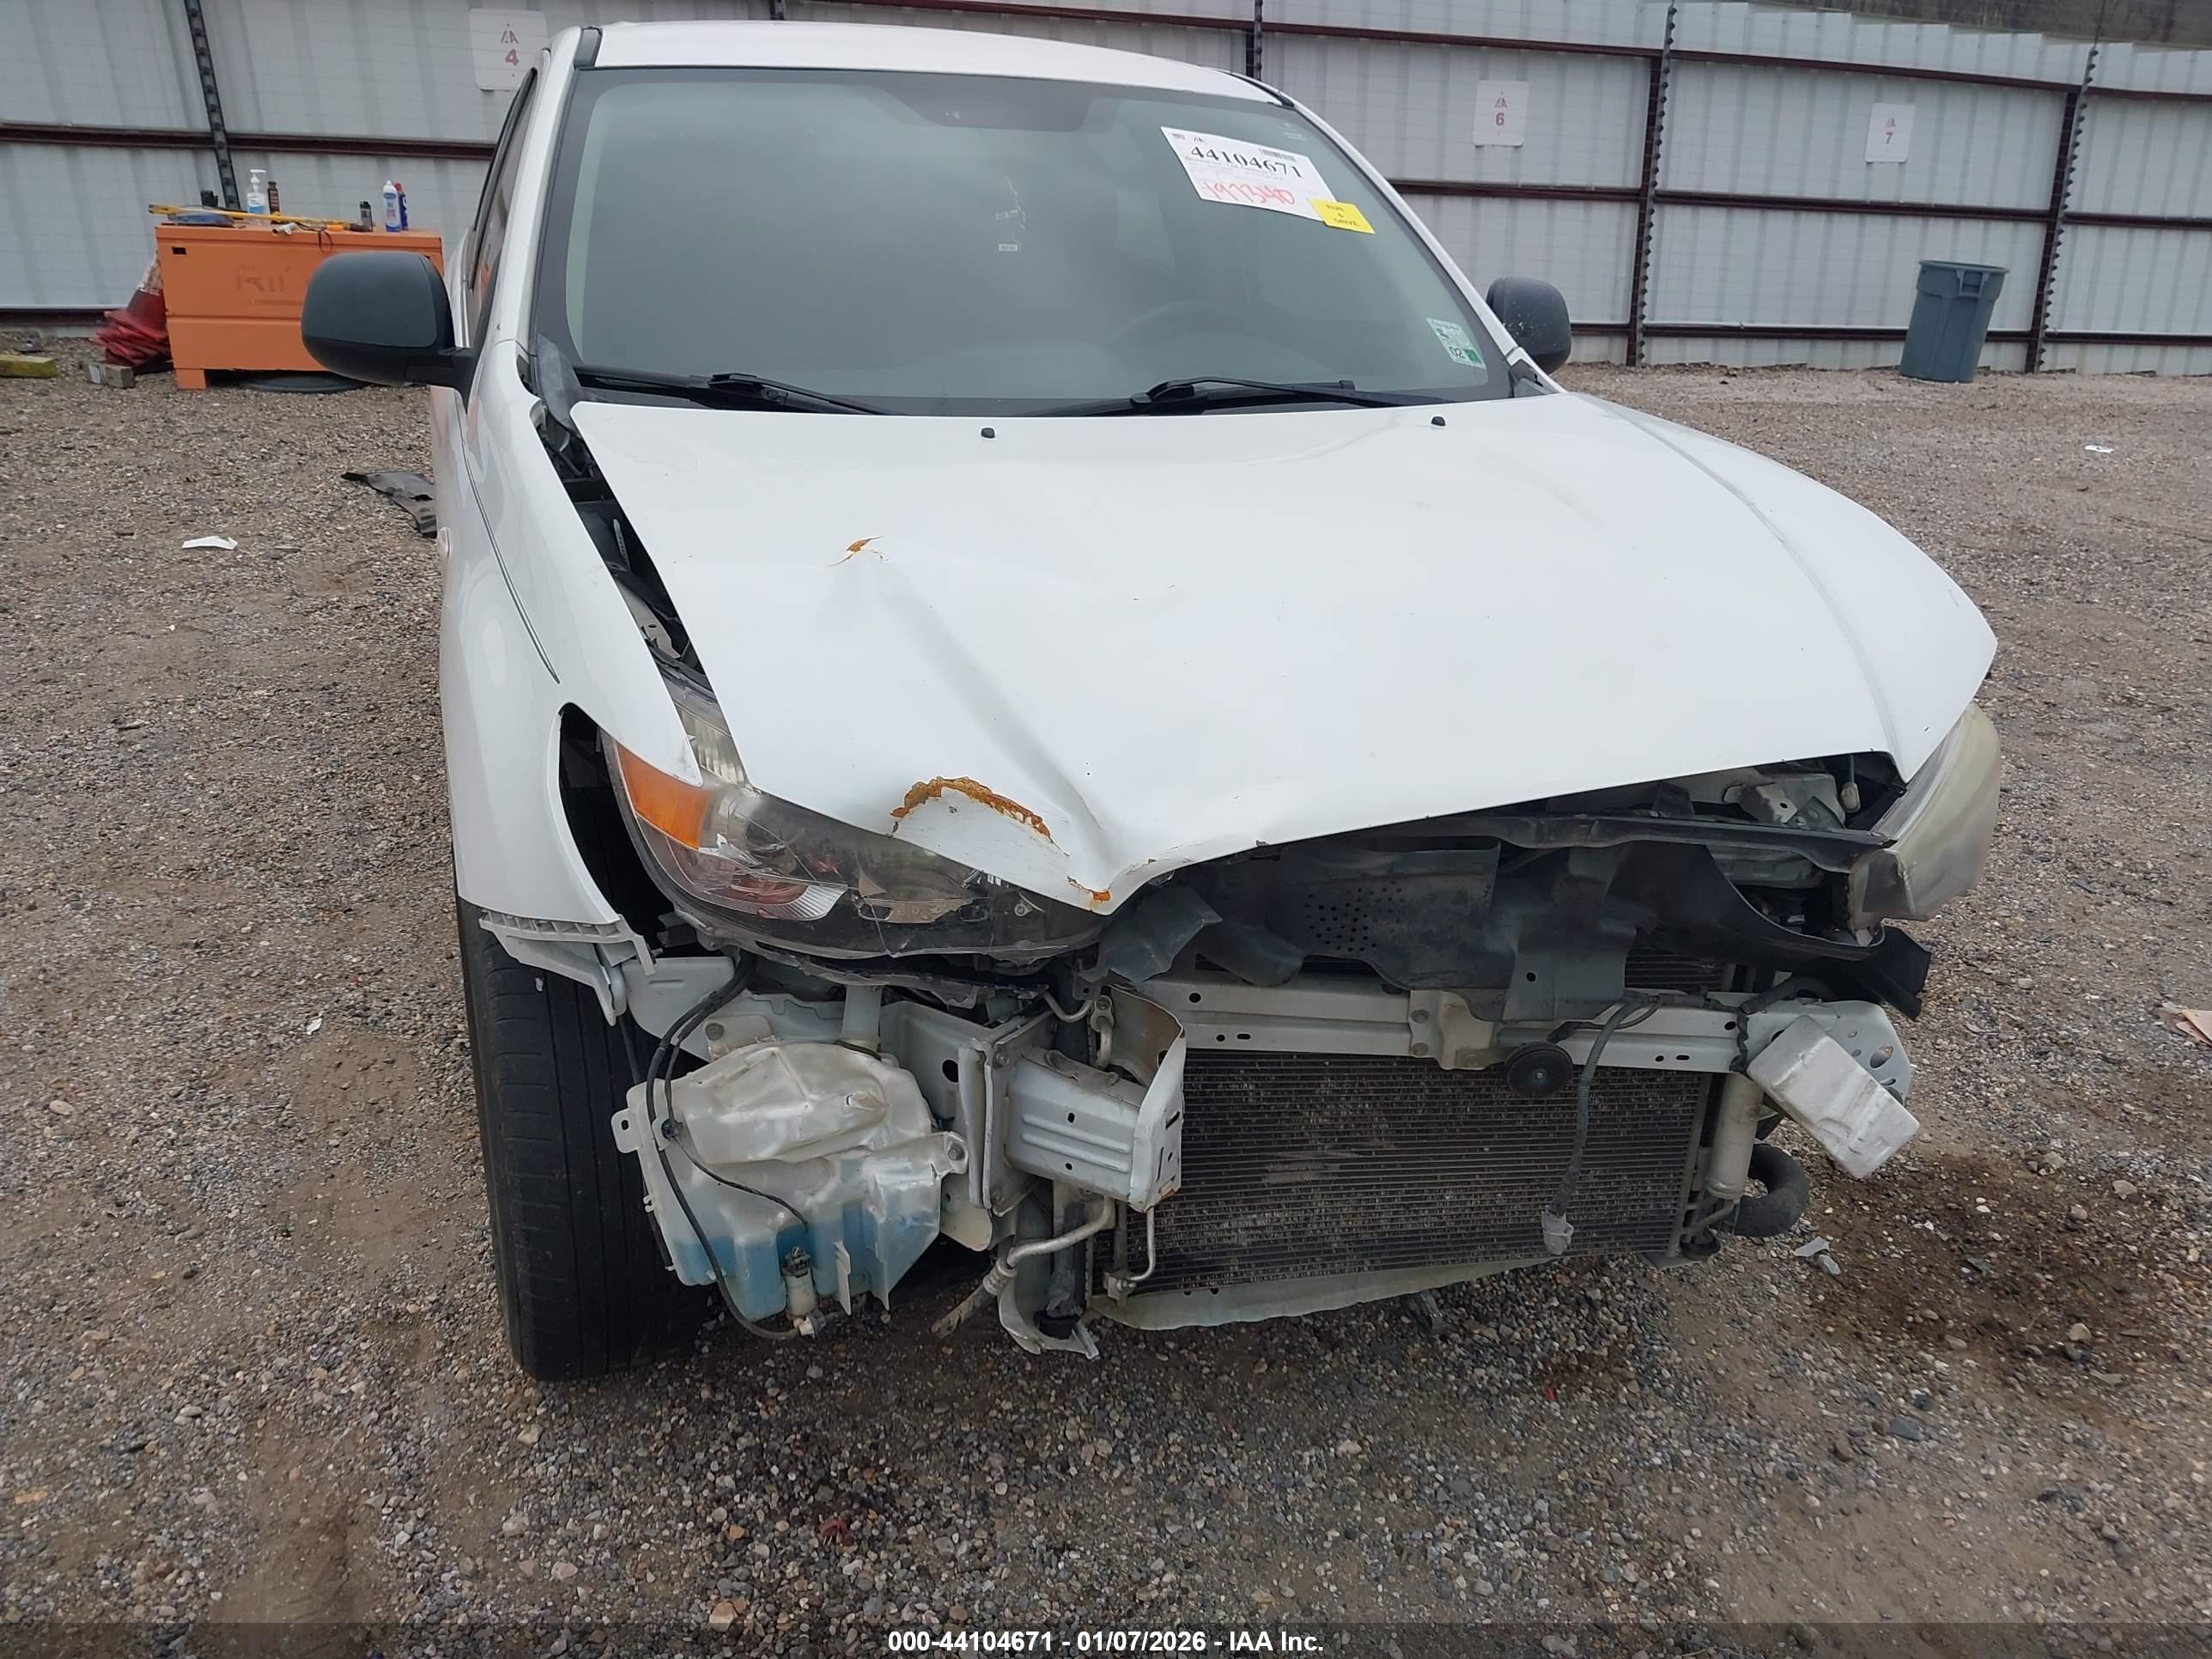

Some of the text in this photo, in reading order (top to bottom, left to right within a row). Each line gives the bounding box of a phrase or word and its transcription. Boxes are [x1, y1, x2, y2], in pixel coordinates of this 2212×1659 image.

[505, 49, 520, 65] 4
[1495, 112, 1505, 126] 6
[1886, 131, 1894, 144] 7
[1191, 146, 1302, 178] 44104671
